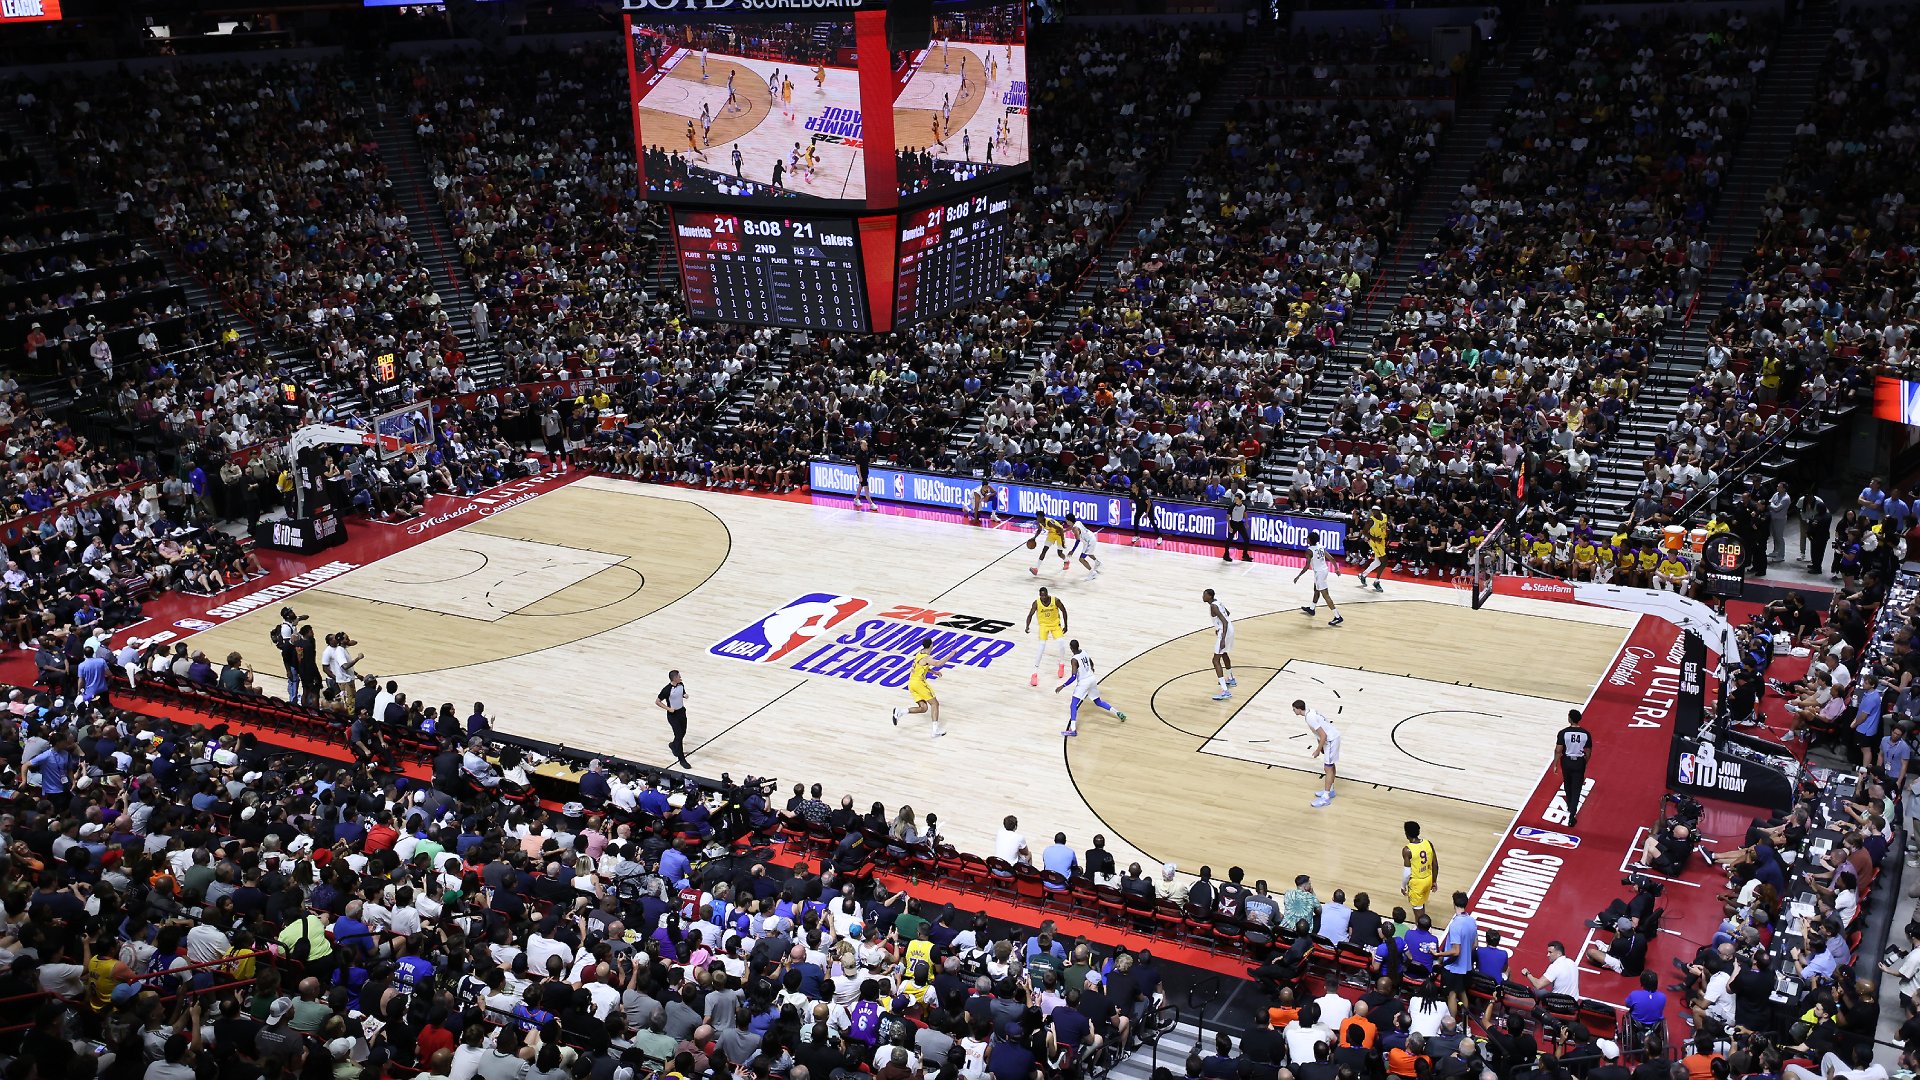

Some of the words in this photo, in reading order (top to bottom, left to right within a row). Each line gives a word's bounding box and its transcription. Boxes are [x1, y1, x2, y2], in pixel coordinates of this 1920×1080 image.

[820, 106, 862, 124] AGUE
[804, 116, 863, 139] UMMER
[927, 209, 941, 228] 21
[946, 201, 969, 222] 8:08
[975, 195, 987, 213] 21
[678, 224, 712, 239] Mavericks
[713, 217, 734, 233] 21
[743, 219, 782, 237] 8:08
[792, 222, 813, 238] 21
[819, 233, 854, 247] Lakers
[950, 226, 963, 239] 2ND
[716, 242, 728, 250] FLS
[731, 242, 738, 252] 3
[754, 244, 777, 254] 2ND
[793, 246, 805, 255] FLS
[808, 247, 815, 257] 2
[376, 353, 394, 366] 8:08
[380, 363, 394, 382] 18
[493, 470, 568, 503] ULTRA
[814, 466, 885, 496] NBAStoreom
[913, 477, 988, 509] NBAStore.c
[1019, 490, 1098, 521] NBAStorecom
[1131, 504, 1215, 536] Store.com
[1718, 543, 1741, 556] 8:08
[1720, 554, 1736, 568] 18
[206, 584, 295, 619] SUMMER
[282, 560, 361, 591] LEAGUE
[876, 604, 1016, 634] 2K26
[718, 639, 766, 657] NBA
[836, 619, 1016, 670] SUMMER
[1080, 656, 1090, 668] 14
[1684, 662, 1698, 673] GET
[1684, 672, 1697, 682] THE
[1628, 677, 1680, 728] ULTRA
[1570, 734, 1581, 744] 64
[1718, 760, 1741, 777] JOIN
[1718, 775, 1747, 793] TODAY
[1419, 850, 1428, 865] 9
[1475, 848, 1564, 919] SUMMER
[1469, 911, 1529, 959] LEA
[857, 1015, 869, 1032] 6
